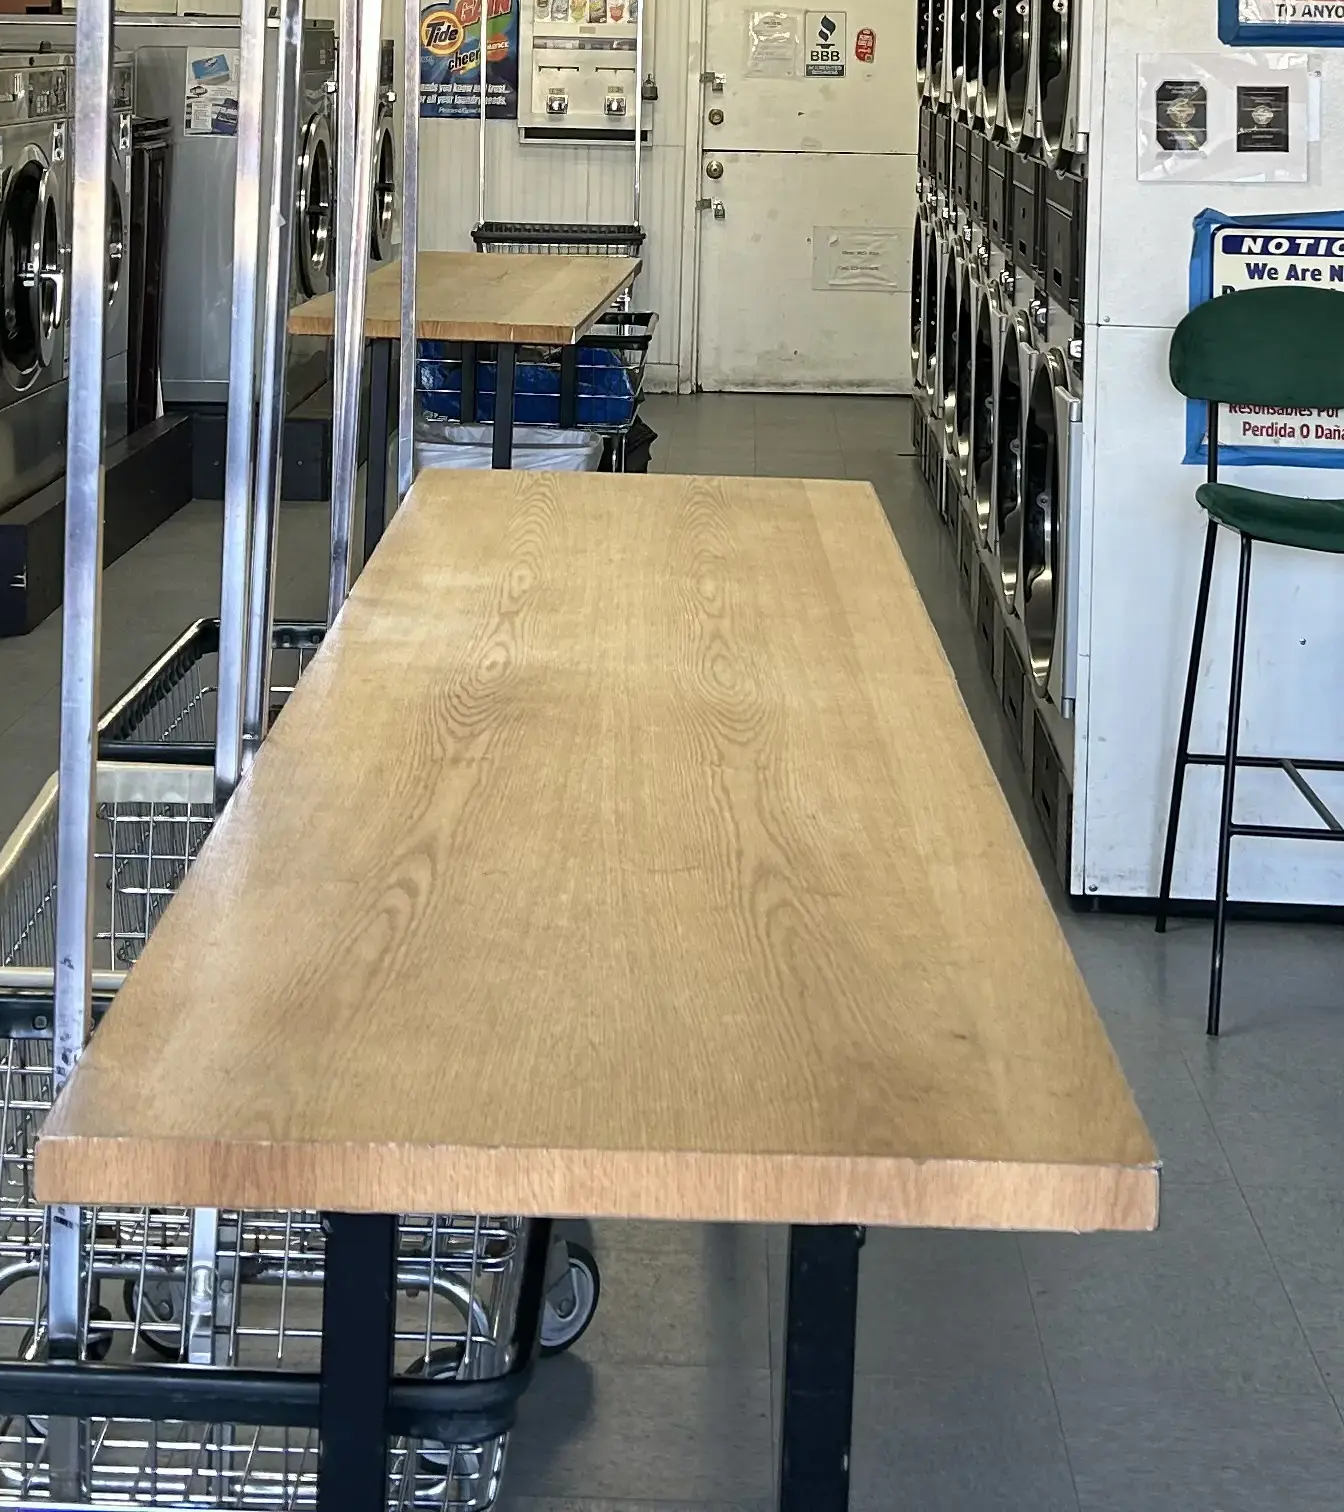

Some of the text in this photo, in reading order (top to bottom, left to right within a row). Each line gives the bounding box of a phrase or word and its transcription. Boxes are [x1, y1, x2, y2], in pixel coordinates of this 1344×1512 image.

[425, 21, 459, 47] Tide
[448, 48, 481, 71] cheer
[810, 50, 840, 62] BBB
[1245, 263, 1279, 281] We
[1285, 264, 1322, 282] Are
[1242, 421, 1296, 439] Perdida
[1300, 424, 1310, 439] O
